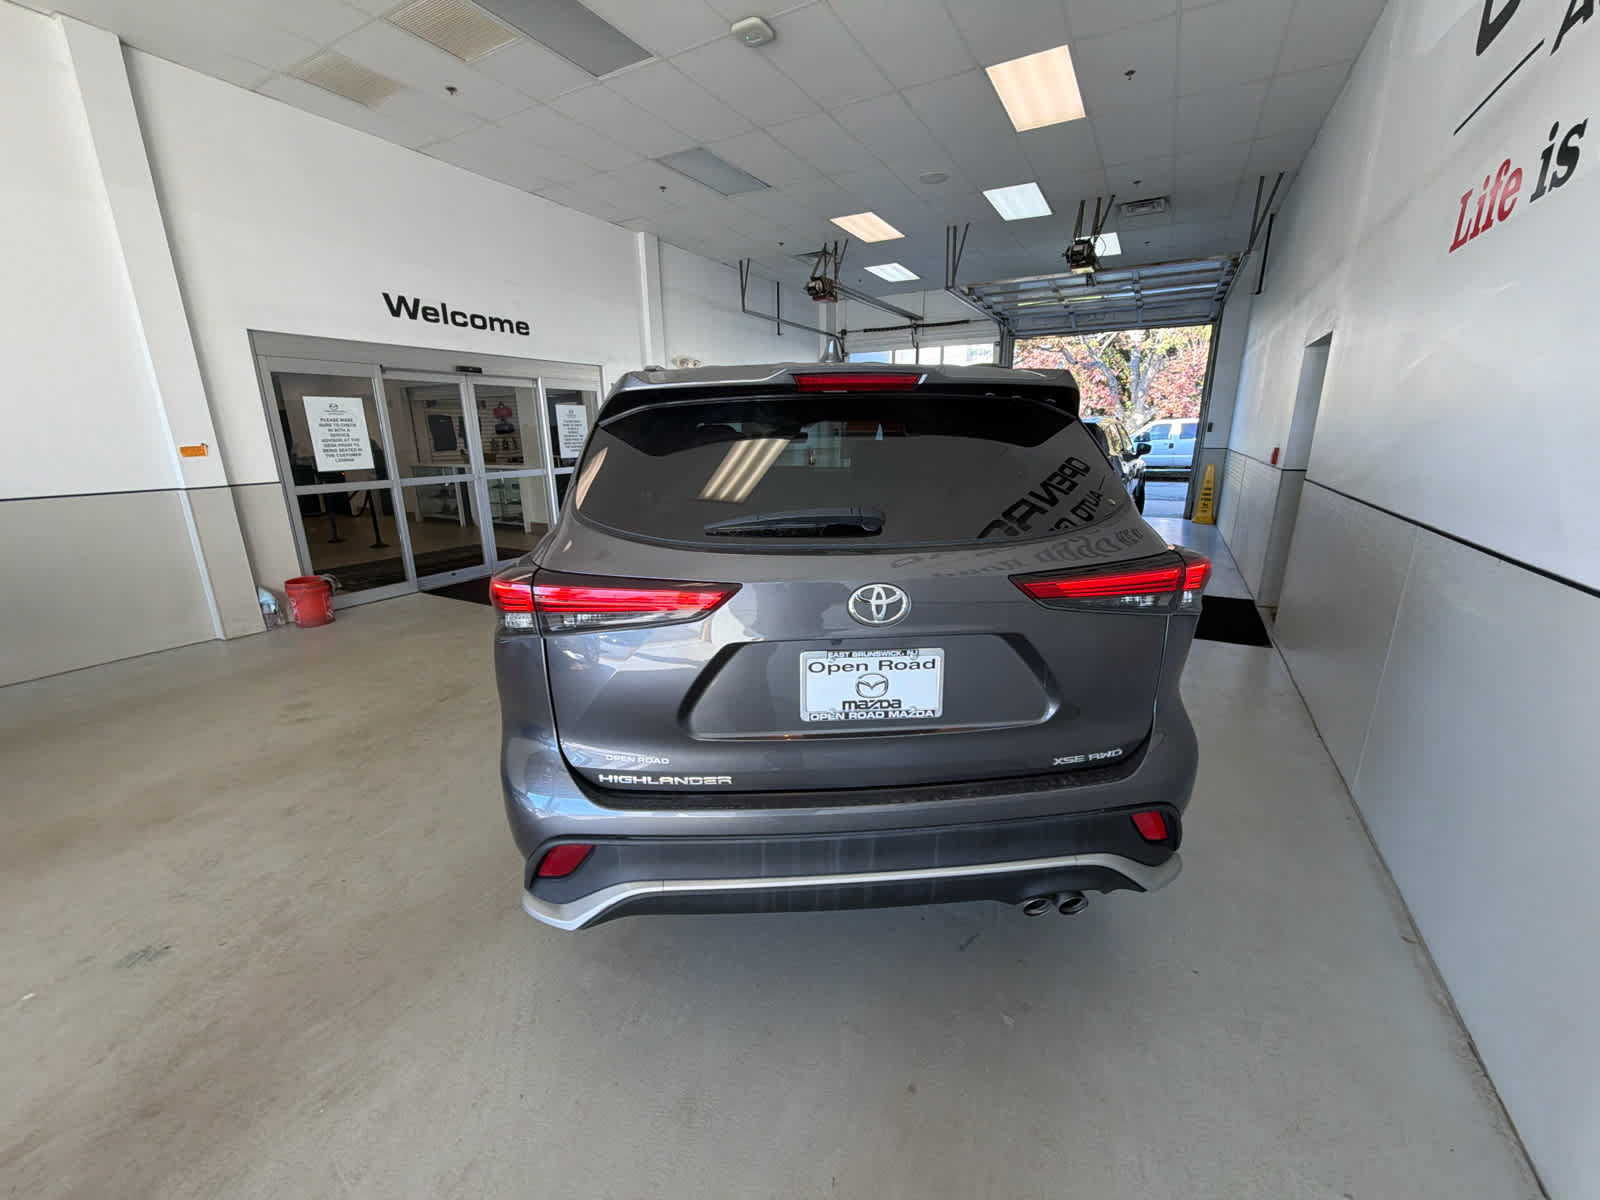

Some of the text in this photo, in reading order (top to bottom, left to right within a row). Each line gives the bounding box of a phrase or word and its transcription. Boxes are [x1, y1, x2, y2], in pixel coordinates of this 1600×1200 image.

[1449, 118, 1589, 254] Life is
[382, 292, 530, 336] Welcome
[808, 658, 936, 675] Open Road
[842, 698, 902, 710] mazda
[810, 709, 935, 720] OPEN ROAD MAZDA
[606, 754, 670, 765] OPEN ROAD
[1053, 748, 1123, 766] XSE AWD
[598, 774, 733, 785] HIGHLANDER
